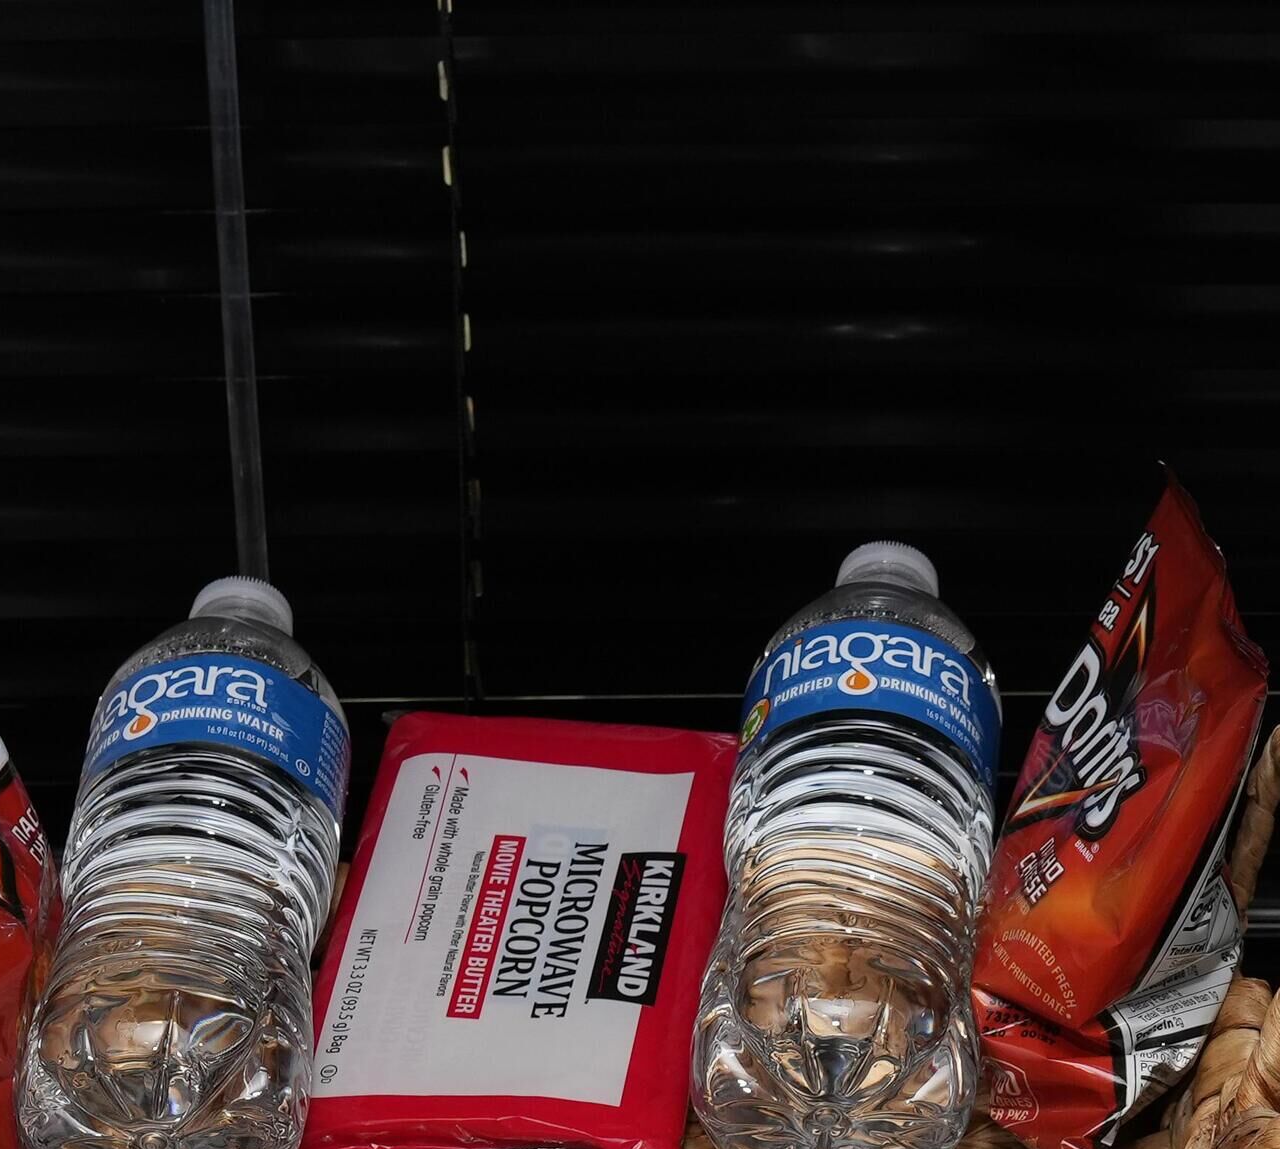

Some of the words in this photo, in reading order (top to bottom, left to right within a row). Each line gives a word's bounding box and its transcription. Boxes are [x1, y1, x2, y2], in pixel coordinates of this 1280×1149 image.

[763, 631, 971, 706] niagara
[94, 665, 268, 742] agara
[774, 676, 833, 707] PURIFIED
[880, 676, 947, 709] DRINKING
[160, 706, 233, 723] DRINKING
[237, 711, 285, 742] WATER
[207, 725, 221, 735] 16.9
[228, 730, 237, 738] oz
[238, 730, 256, 744] (1.05
[256, 738, 268, 751] PT)
[412, 784, 440, 840] Gluten-free
[449, 786, 469, 815] Made
[444, 818, 459, 839] with
[434, 842, 453, 873] whole
[470, 851, 486, 873] Natural
[488, 840, 519, 886] MOVIE
[1074, 839, 1094, 863] BRAND
[428, 875, 444, 900] grain
[465, 874, 479, 893] Butter
[459, 894, 473, 913] Flavor
[415, 903, 436, 941] popcorn
[455, 914, 466, 929] with
[472, 889, 506, 953] THEATER
[492, 859, 562, 998] POPCORN
[531, 842, 609, 1019] MICROWAVE
[598, 859, 641, 992] Signature
[616, 860, 675, 997] KIRKLAND
[360, 929, 378, 946] NET
[450, 930, 464, 948] Other
[356, 946, 372, 963] WT
[443, 949, 459, 972] Natural
[350, 964, 367, 980] 3.3
[994, 943, 1010, 967] UNTIL
[1008, 961, 1042, 997] PRINTED
[1042, 992, 1067, 1016] DATE
[1001, 928, 1056, 967] GUARANTEED
[1051, 966, 1077, 1009] FRESH
[345, 981, 362, 995] OZ
[436, 973, 452, 997] Flavors
[454, 957, 488, 1014] BUTTER
[338, 996, 360, 1020] (93.5
[1139, 1010, 1158, 1022] Total
[332, 1022, 351, 1033] g)
[325, 1034, 348, 1054] Bag
